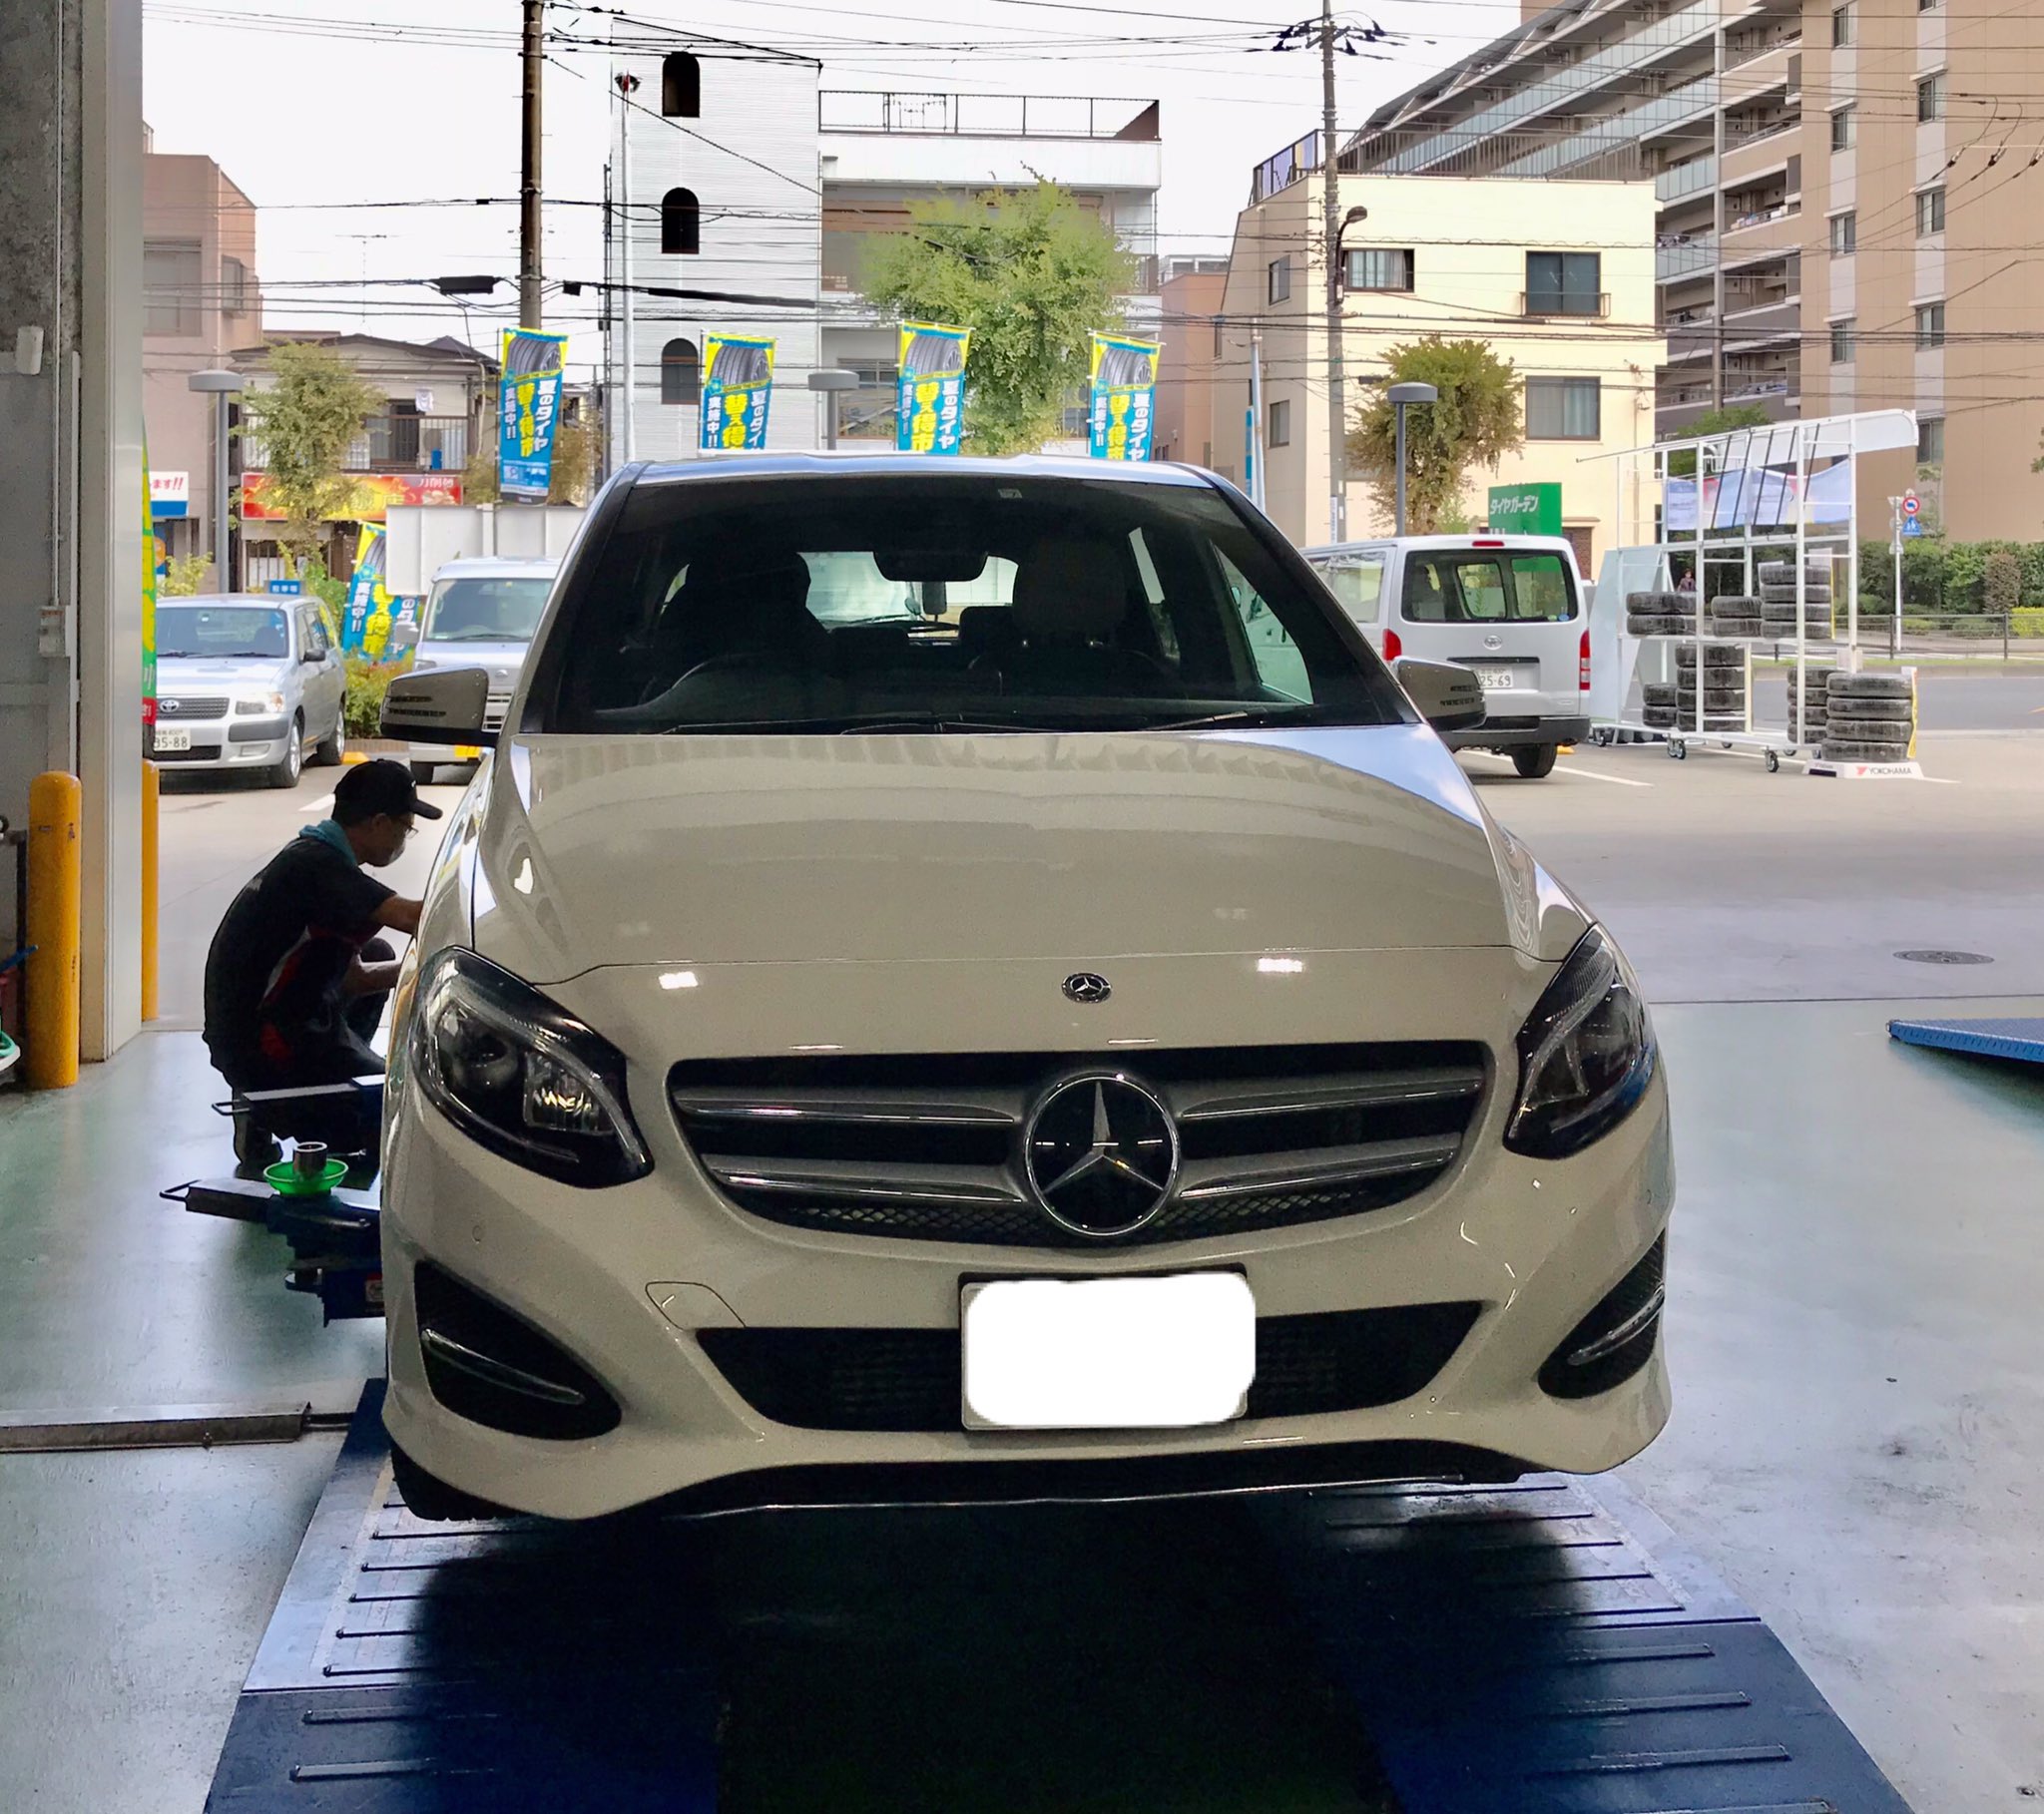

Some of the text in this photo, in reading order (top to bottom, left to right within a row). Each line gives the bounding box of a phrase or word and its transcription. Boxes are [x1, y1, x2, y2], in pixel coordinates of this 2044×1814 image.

[722, 393, 748, 449] 替え得
[748, 389, 767, 450] 夏のタイ
[1489, 494, 1539, 515] タイヤガーデン
[1869, 766, 1912, 775] YOKOHAMA
